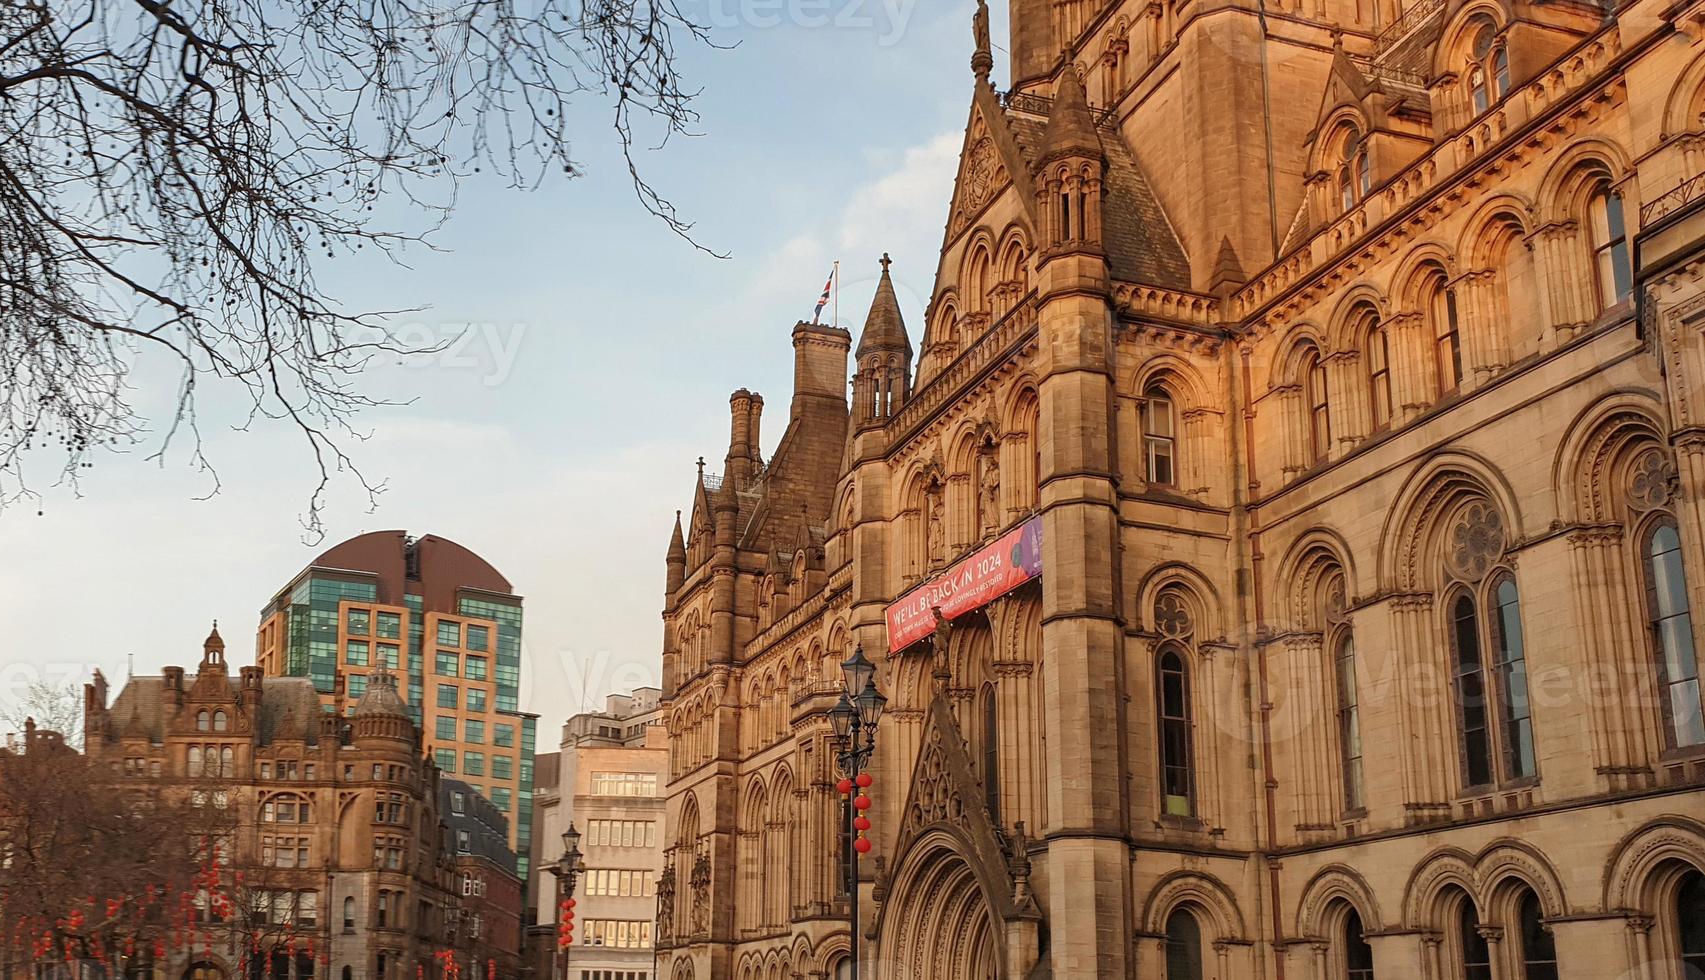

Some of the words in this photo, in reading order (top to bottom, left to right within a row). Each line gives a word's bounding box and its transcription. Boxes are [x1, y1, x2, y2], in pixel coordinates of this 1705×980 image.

[893, 602, 918, 625] WE'LL
[920, 594, 931, 612] BE
[933, 579, 959, 603] BACK
[961, 568, 973, 587] IN
[977, 551, 1002, 579] 2024
[955, 587, 980, 604] LOVINGLY
